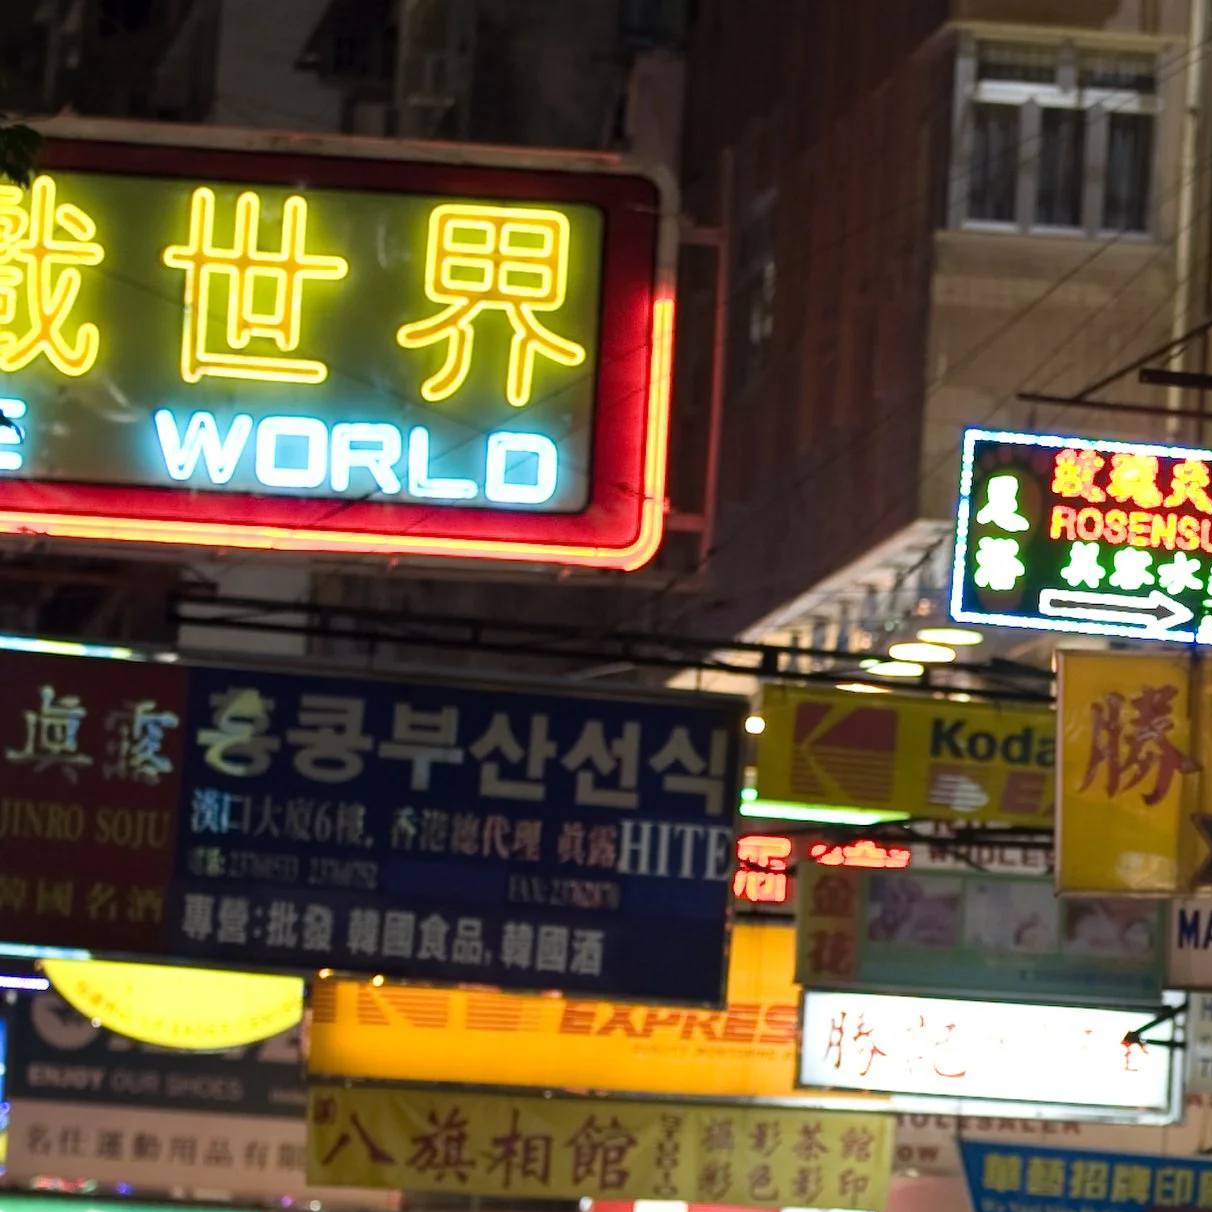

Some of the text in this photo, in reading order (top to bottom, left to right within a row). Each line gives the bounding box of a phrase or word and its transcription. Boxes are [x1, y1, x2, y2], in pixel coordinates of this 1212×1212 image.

[155, 407, 559, 505] WORLD
[196, 686, 728, 816] 홍콩부산선식
[617, 818, 733, 882] HITE
